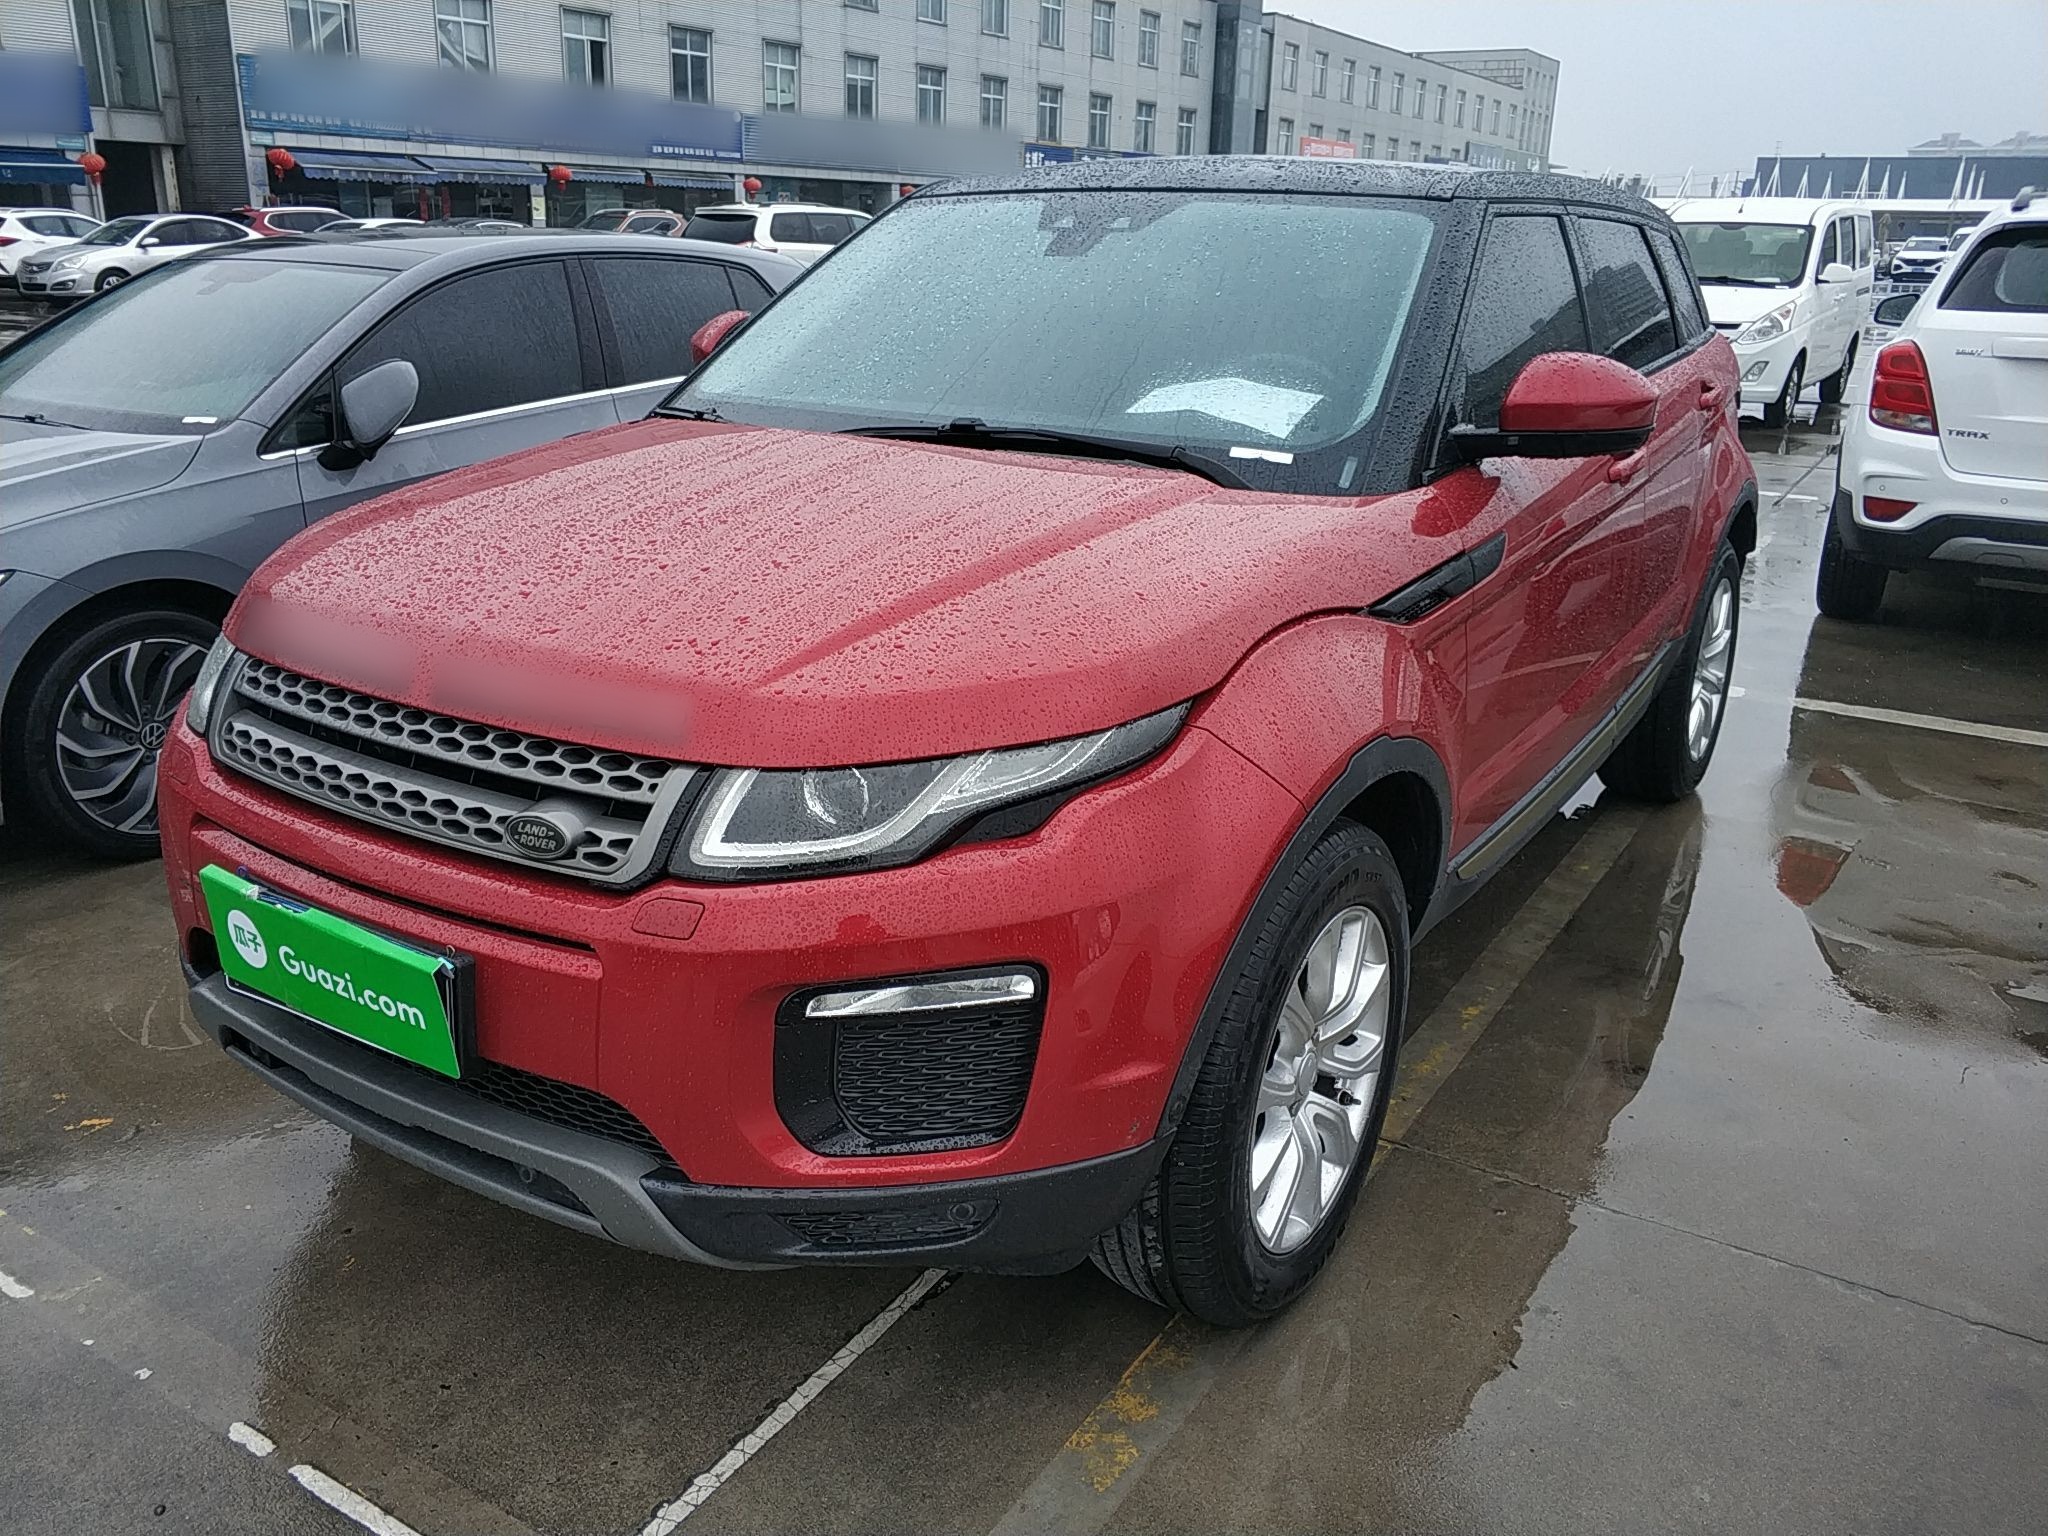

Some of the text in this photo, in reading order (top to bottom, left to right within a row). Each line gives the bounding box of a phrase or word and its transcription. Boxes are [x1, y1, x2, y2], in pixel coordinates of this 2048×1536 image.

[517, 822, 547, 837] LAND
[520, 834, 557, 851] ROVER
[233, 923, 262, 953] 瓜子
[278, 945, 427, 1031] Guazi.com
